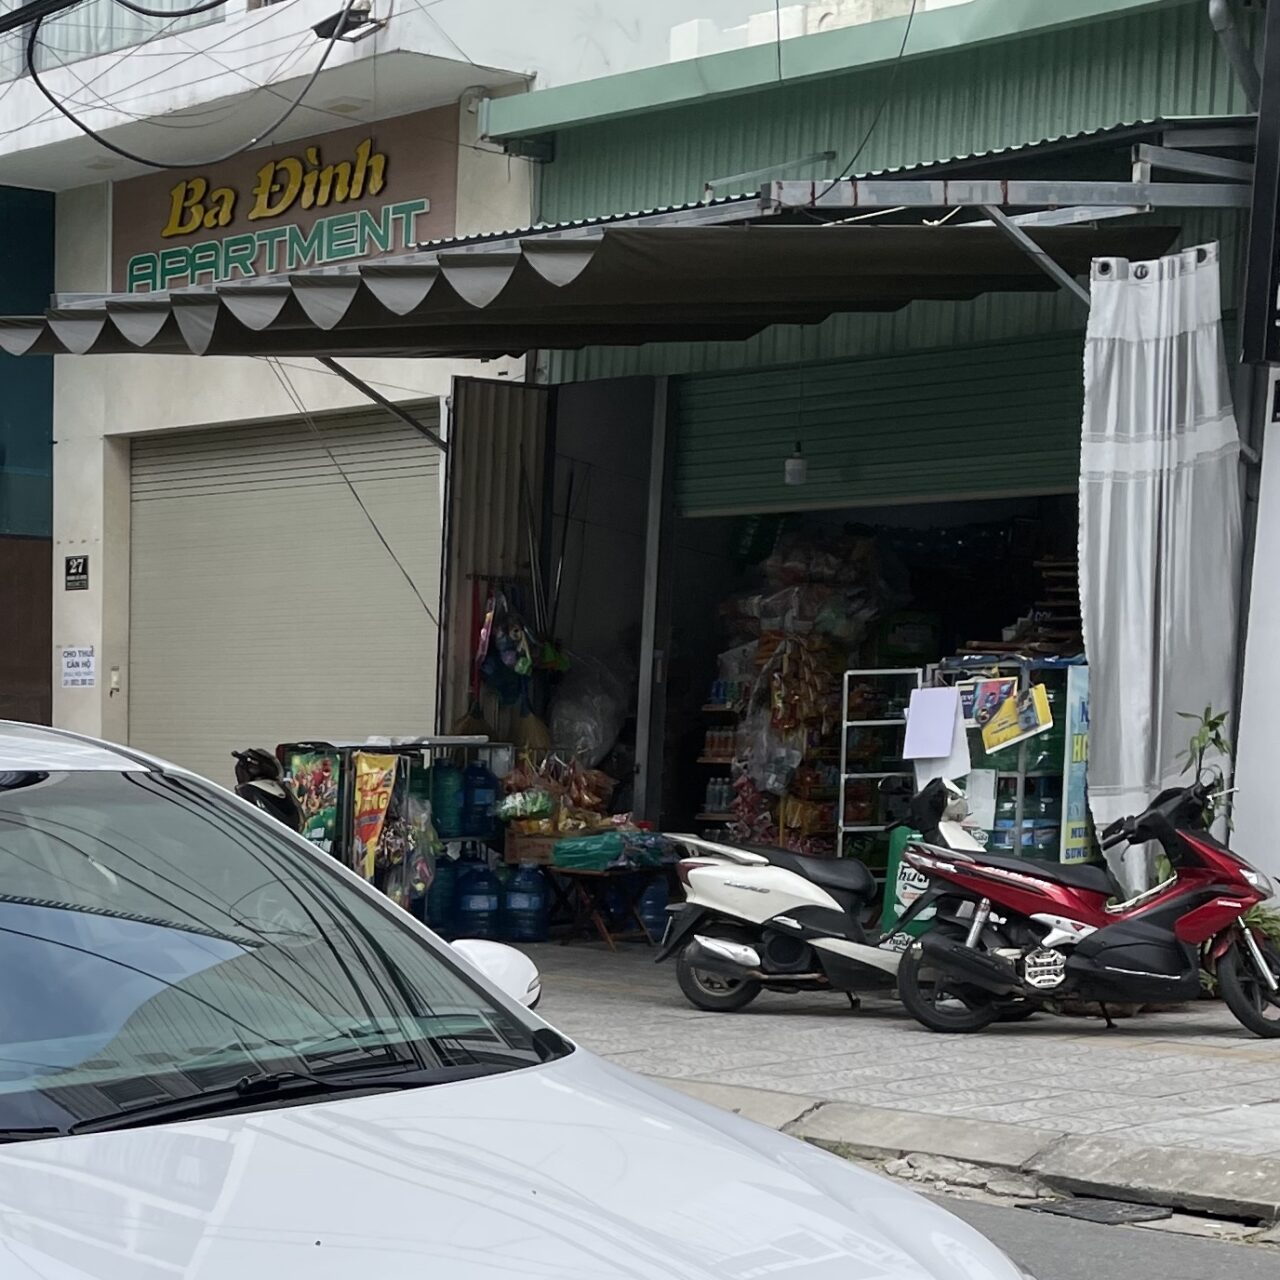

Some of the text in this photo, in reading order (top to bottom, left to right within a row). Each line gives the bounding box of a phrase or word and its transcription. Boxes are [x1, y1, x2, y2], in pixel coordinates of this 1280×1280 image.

[161, 138, 386, 237] Ba Đình
[127, 198, 429, 293] APARTMENT
[69, 558, 84, 573] 27
